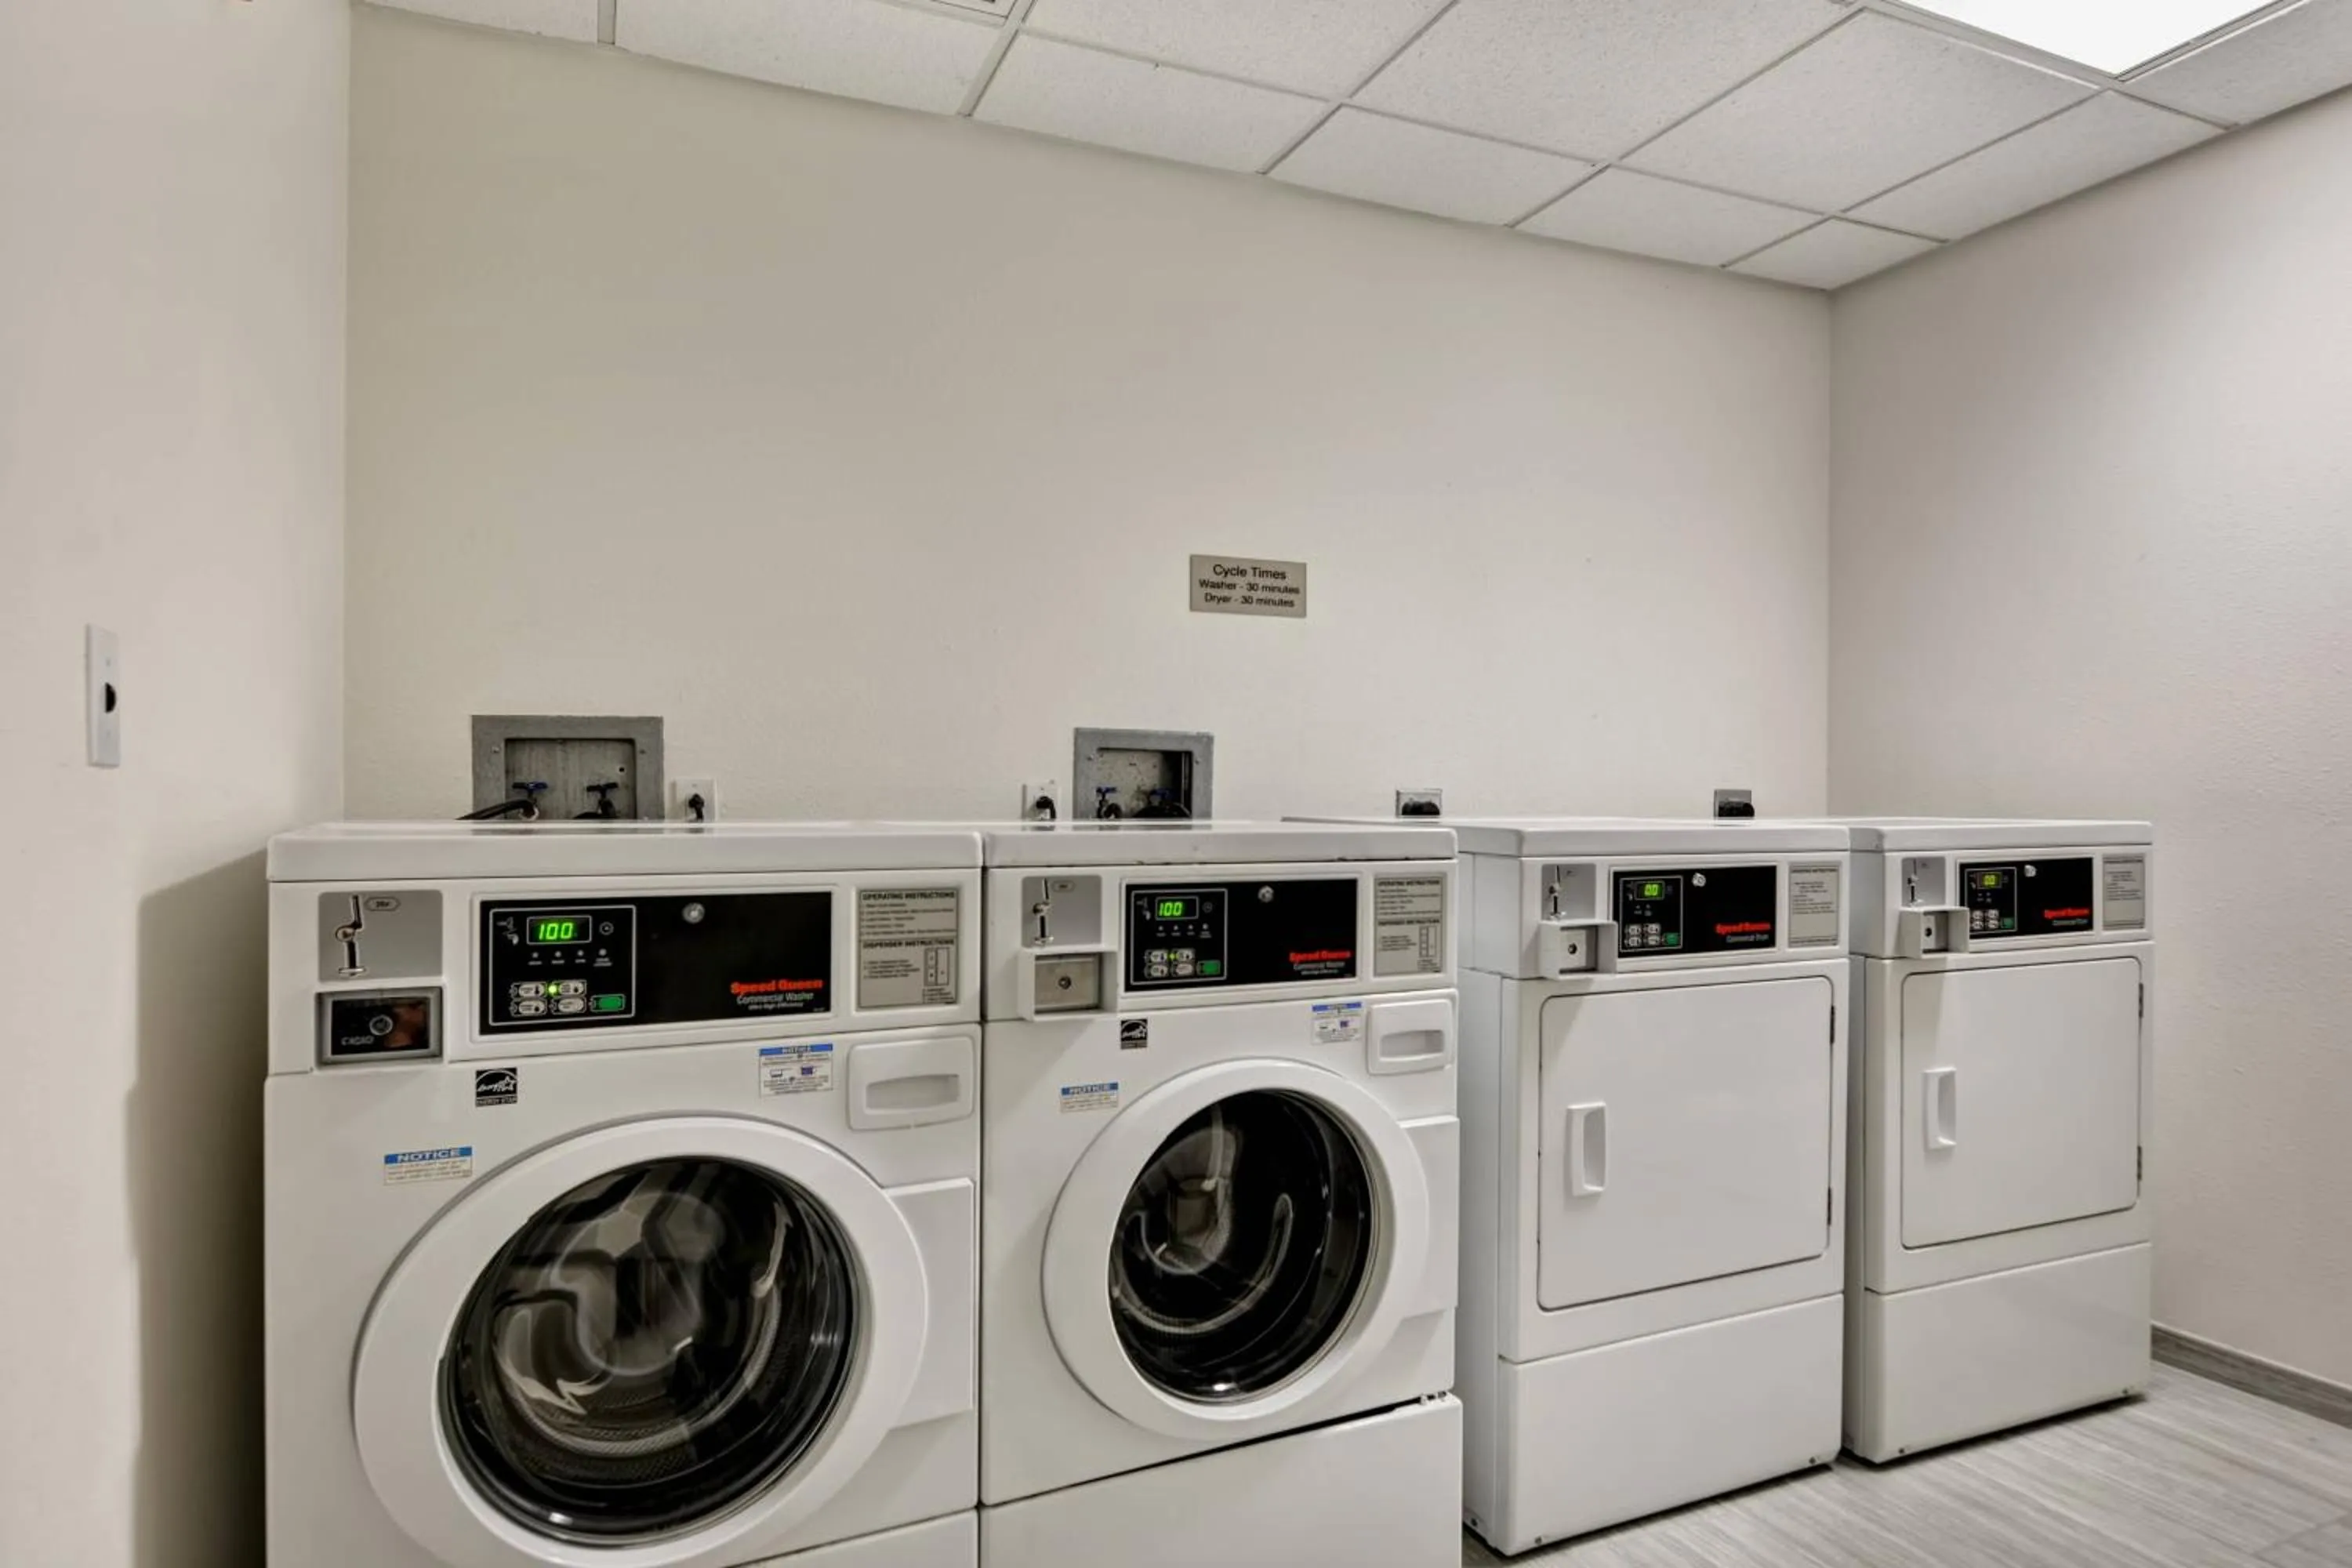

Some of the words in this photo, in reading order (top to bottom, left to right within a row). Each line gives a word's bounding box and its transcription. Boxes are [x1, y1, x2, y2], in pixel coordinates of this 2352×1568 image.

[1212, 563, 1247, 578] Cycle
[1250, 566, 1287, 580] Times
[1199, 579, 1237, 590] Washer
[1247, 583, 1259, 592] 30
[1261, 584, 1301, 594] minutes
[1204, 592, 1232, 604] Dryer
[1241, 595, 1253, 604] 30
[1255, 597, 1295, 608] minutes
[1159, 902, 1183, 916] 100
[538, 922, 575, 941] 100
[730, 979, 776, 996] Speed
[778, 978, 823, 991] Queen
[737, 993, 784, 1004] Commercial
[785, 992, 814, 1002] Washer
[397, 1148, 459, 1164] NOTICE
